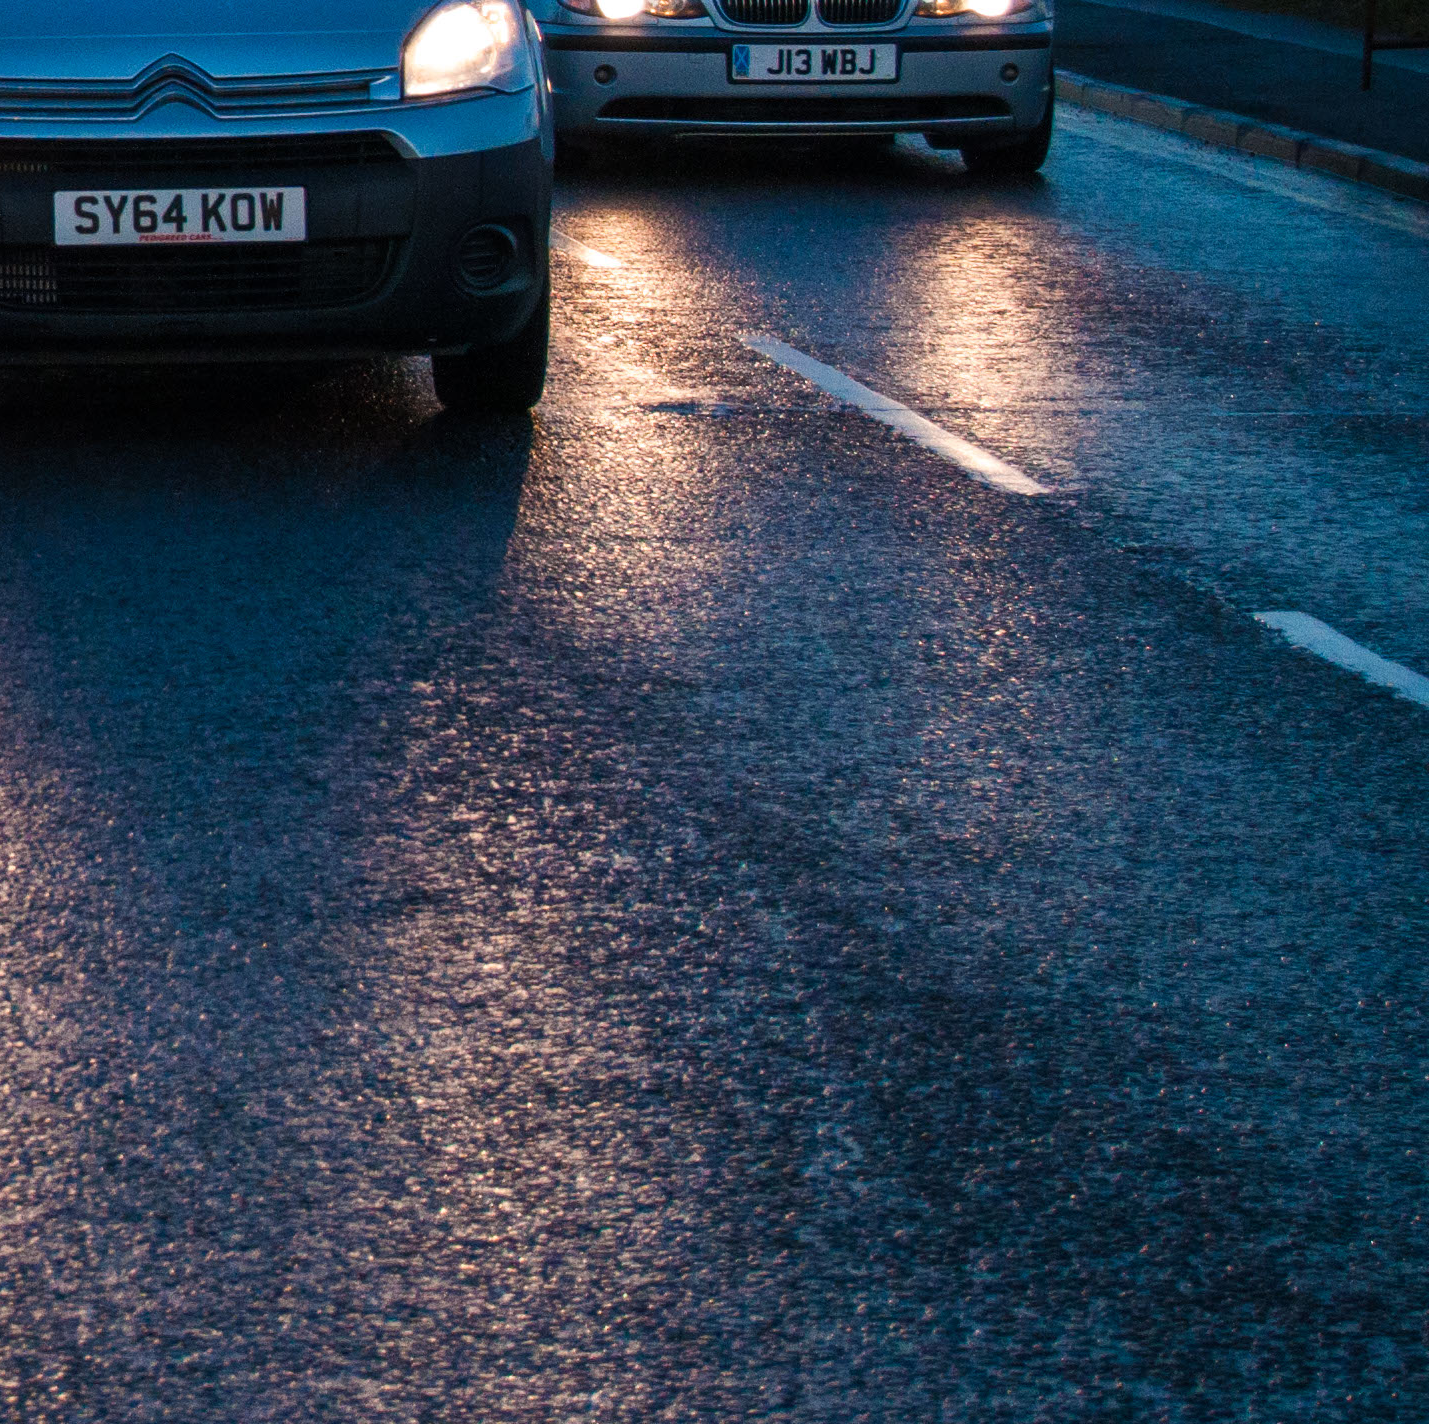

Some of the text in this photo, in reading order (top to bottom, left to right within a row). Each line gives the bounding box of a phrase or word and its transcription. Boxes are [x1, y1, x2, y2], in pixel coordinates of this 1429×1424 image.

[767, 48, 876, 75] J13 WBJ
[73, 192, 284, 235] SY64 KOW
